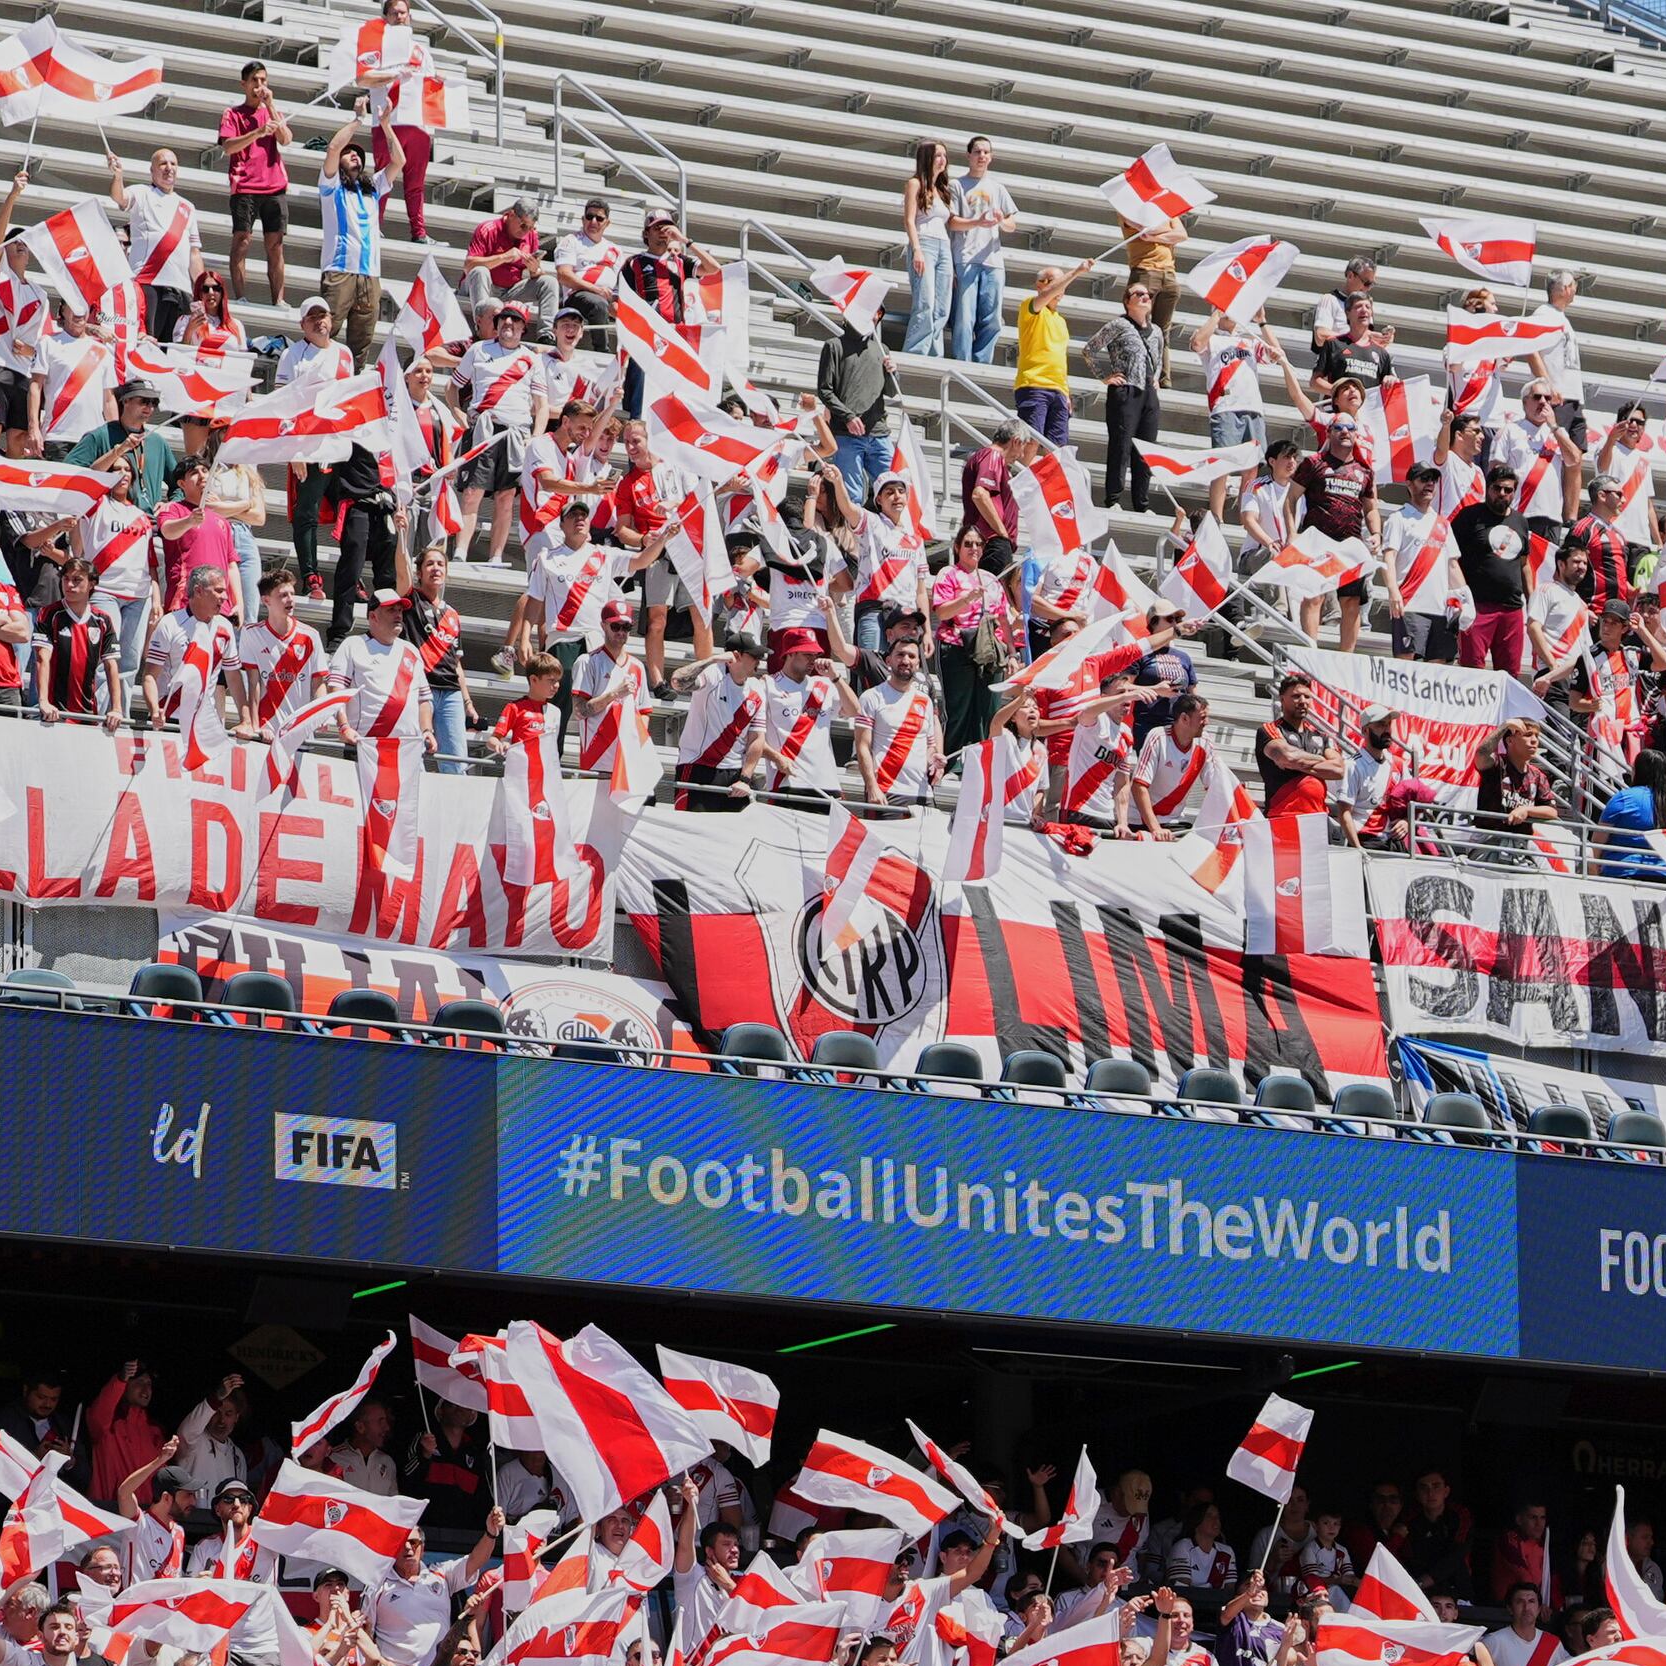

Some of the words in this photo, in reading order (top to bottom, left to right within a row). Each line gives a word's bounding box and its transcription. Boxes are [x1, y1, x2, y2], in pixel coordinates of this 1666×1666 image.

[1345, 357, 1379, 371] TURKISH
[1324, 478, 1364, 492] TURKISH
[188, 797, 323, 926] DE
[347, 826, 605, 953] MAYO
[962, 885, 1331, 1105] LIMA
[149, 1102, 212, 1180] ld
[291, 1128, 382, 1175] FIFA
[557, 1131, 1454, 1275] #FootballUnitesTheWorld
